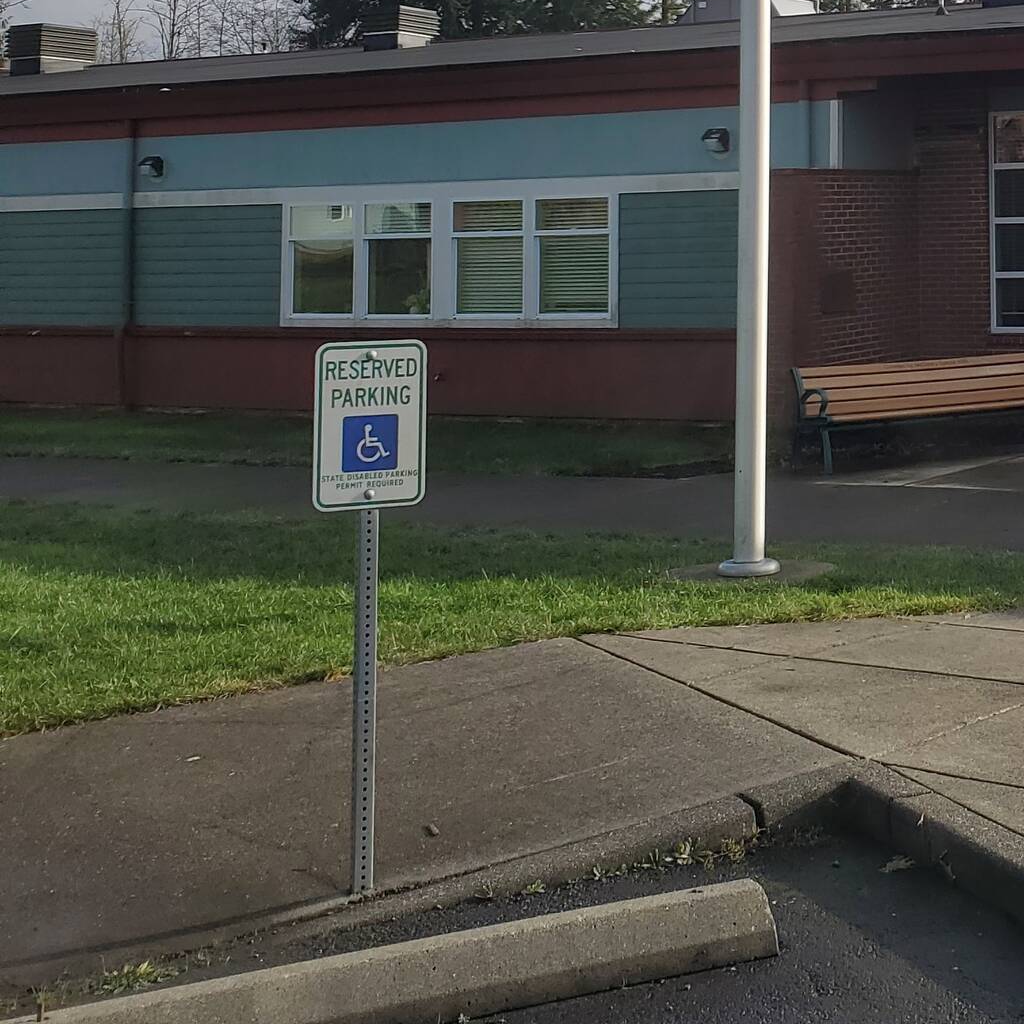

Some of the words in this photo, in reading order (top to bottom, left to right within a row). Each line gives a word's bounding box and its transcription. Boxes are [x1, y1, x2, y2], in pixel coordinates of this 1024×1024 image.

[325, 358, 417, 381] RESERVED
[331, 385, 411, 408] PARKING
[321, 474, 344, 483] STATE
[347, 472, 383, 481] DISABLED
[385, 469, 418, 478] PARKING
[336, 481, 362, 490] PERMIT
[366, 479, 404, 488] REQUIRED
